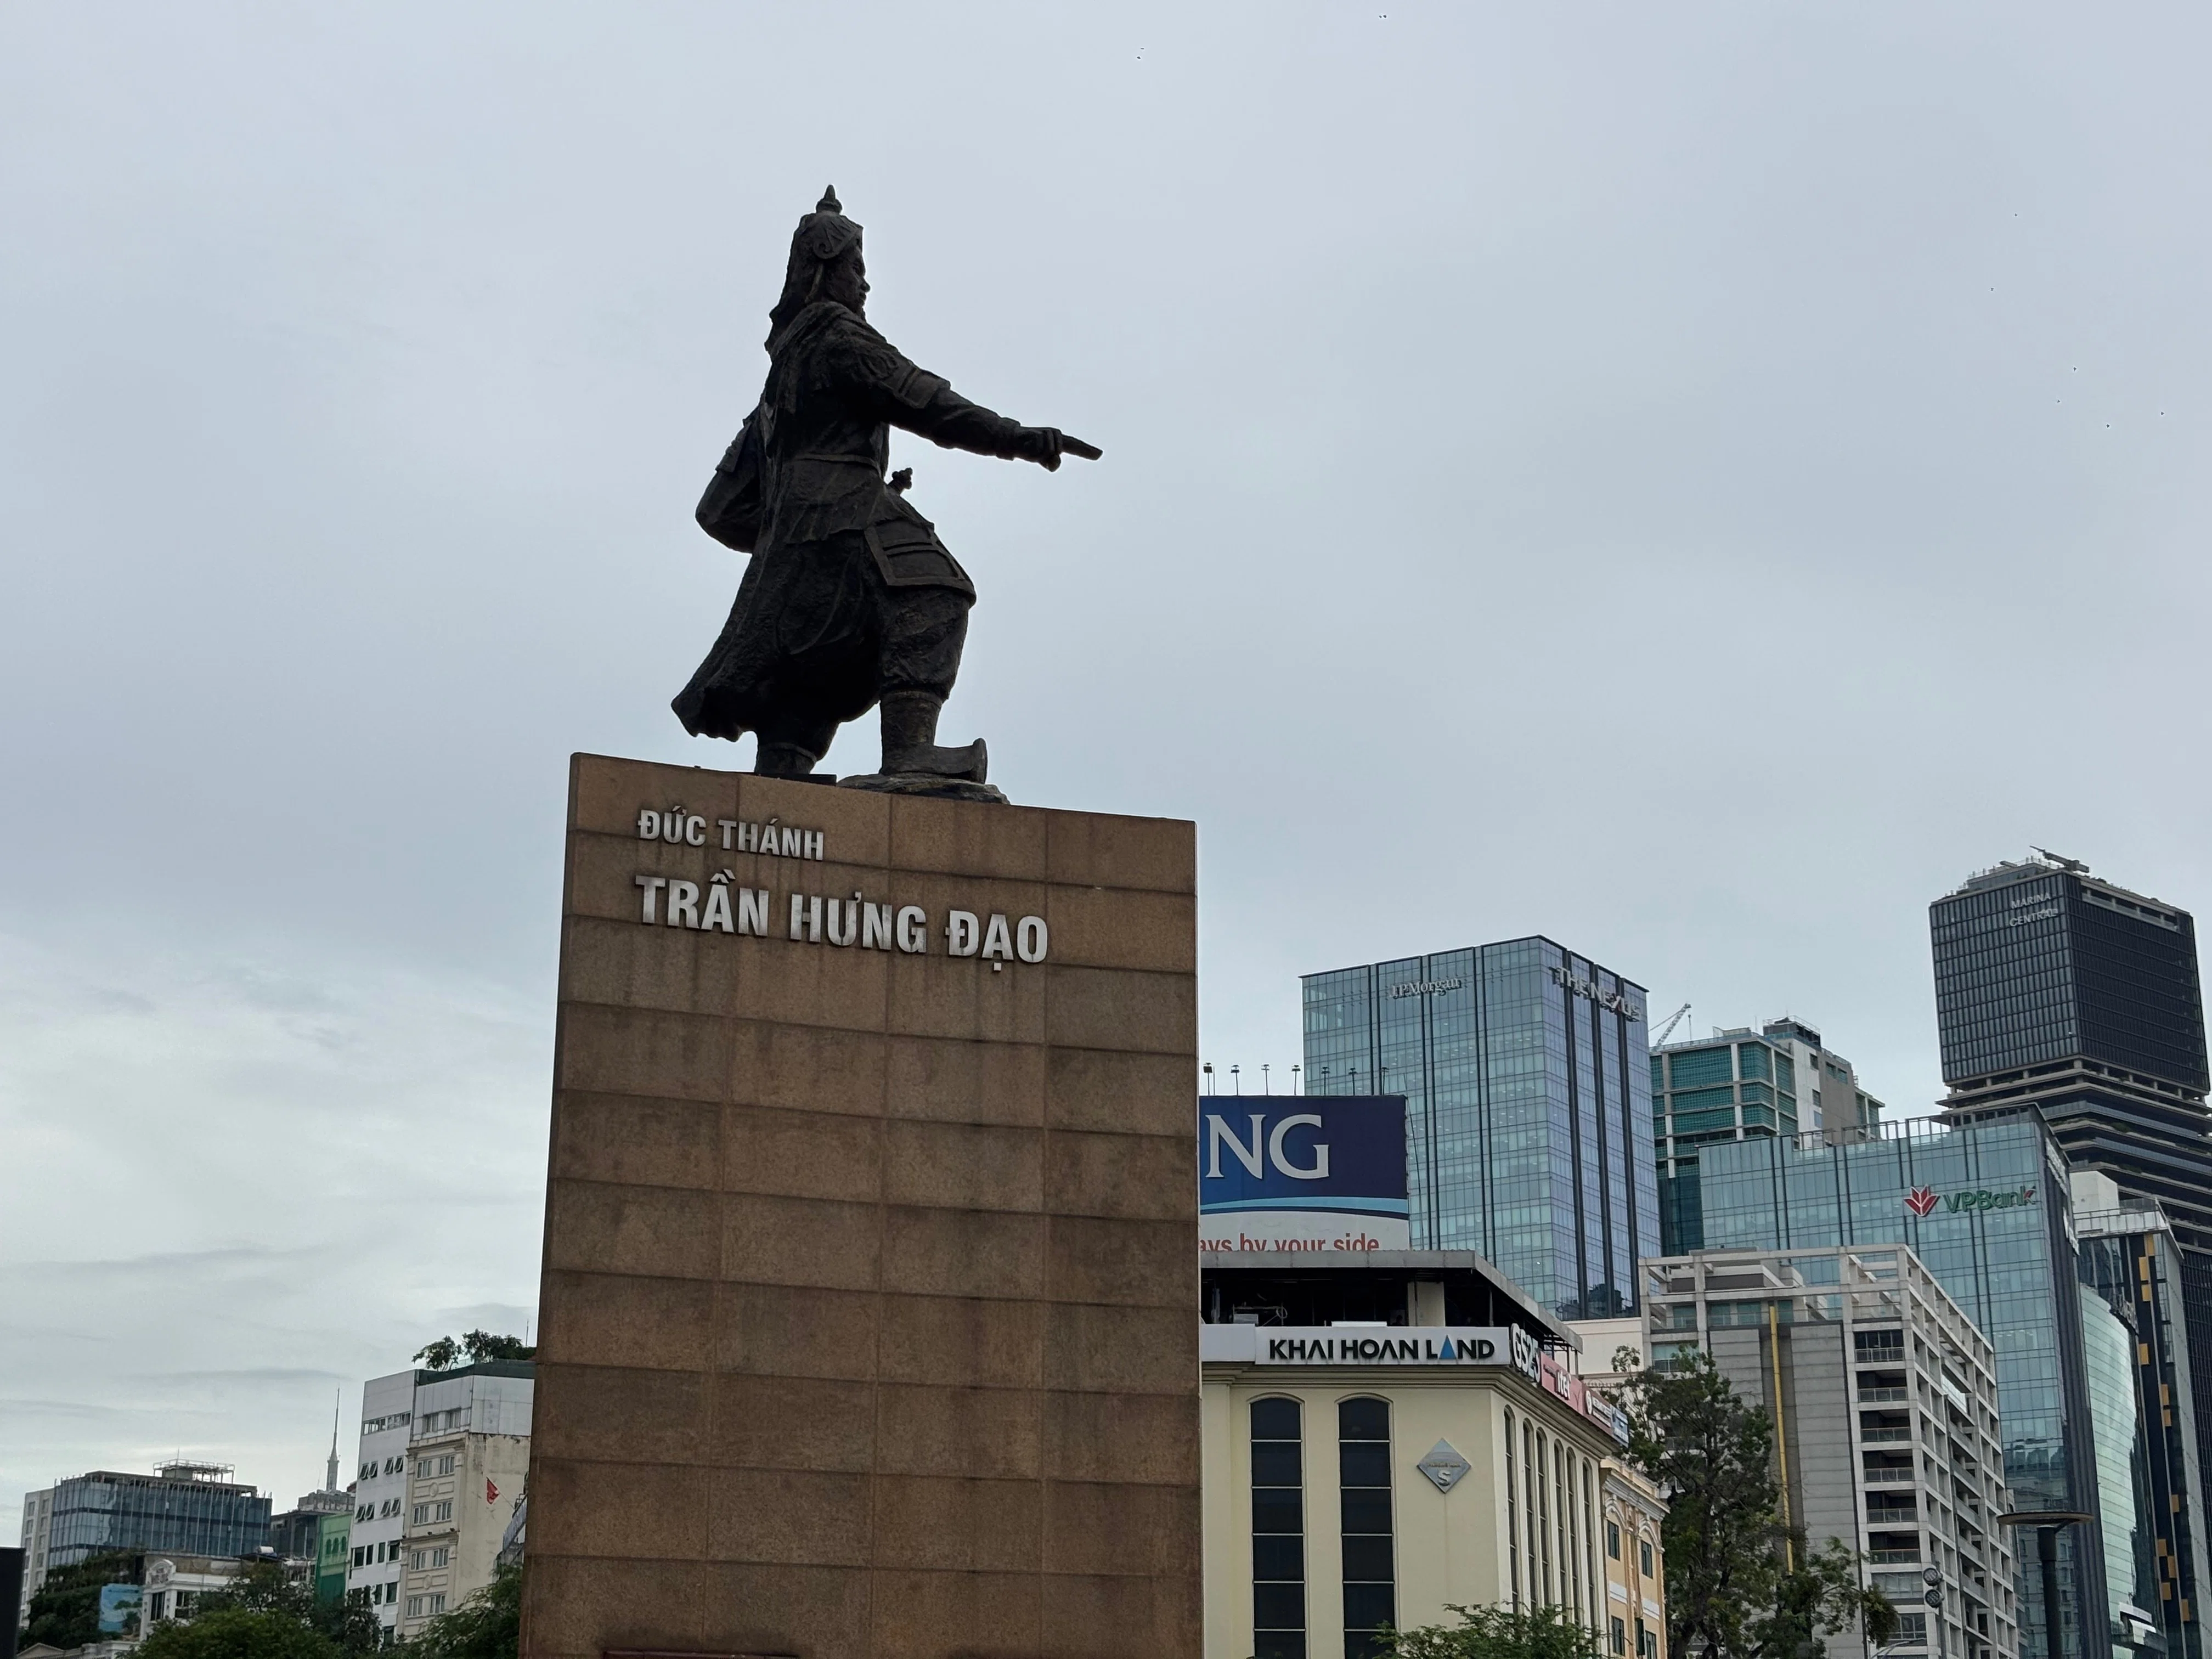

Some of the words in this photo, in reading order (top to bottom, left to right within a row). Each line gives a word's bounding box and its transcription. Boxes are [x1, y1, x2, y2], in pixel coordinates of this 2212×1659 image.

[637, 805, 706, 846] ĐỨC
[718, 818, 824, 861] THÁNH
[2009, 909, 2058, 927] CENTRAL
[2011, 892, 2051, 909] MARINA
[635, 869, 769, 937] TRẦN
[790, 891, 927, 953] HƯNG
[945, 910, 1048, 971] ĐẠO
[1589, 981, 1641, 1023] NEXUS
[1205, 1114, 1330, 1180] NG
[1943, 1185, 2036, 1214] VPBank
[1333, 1232, 1380, 1251] side
[1269, 1339, 1334, 1361] KHAI
[1341, 1339, 1419, 1361] HOAN
[1426, 1334, 1495, 1361] LAND
[1510, 1323, 1541, 1383] GS25
